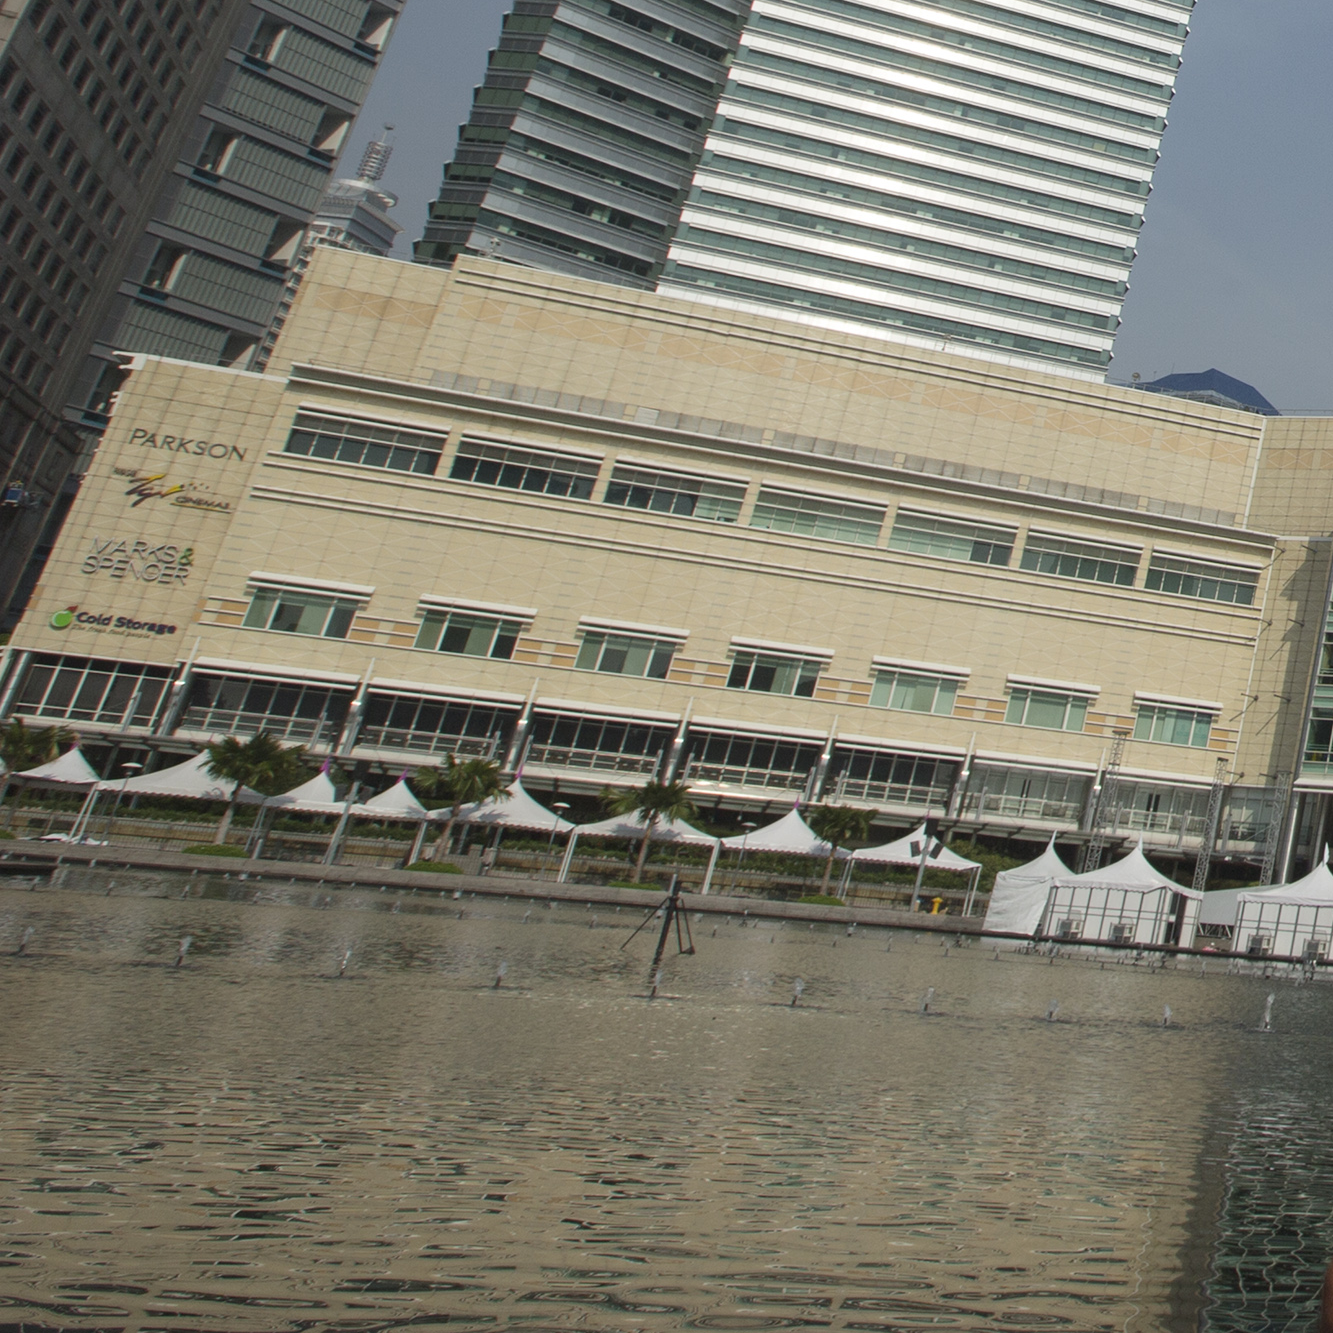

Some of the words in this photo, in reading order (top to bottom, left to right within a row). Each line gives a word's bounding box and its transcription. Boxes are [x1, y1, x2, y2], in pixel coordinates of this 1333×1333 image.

[128, 427, 248, 462] PARKSON
[76, 611, 114, 626] Cold
[114, 616, 177, 634] Storage
